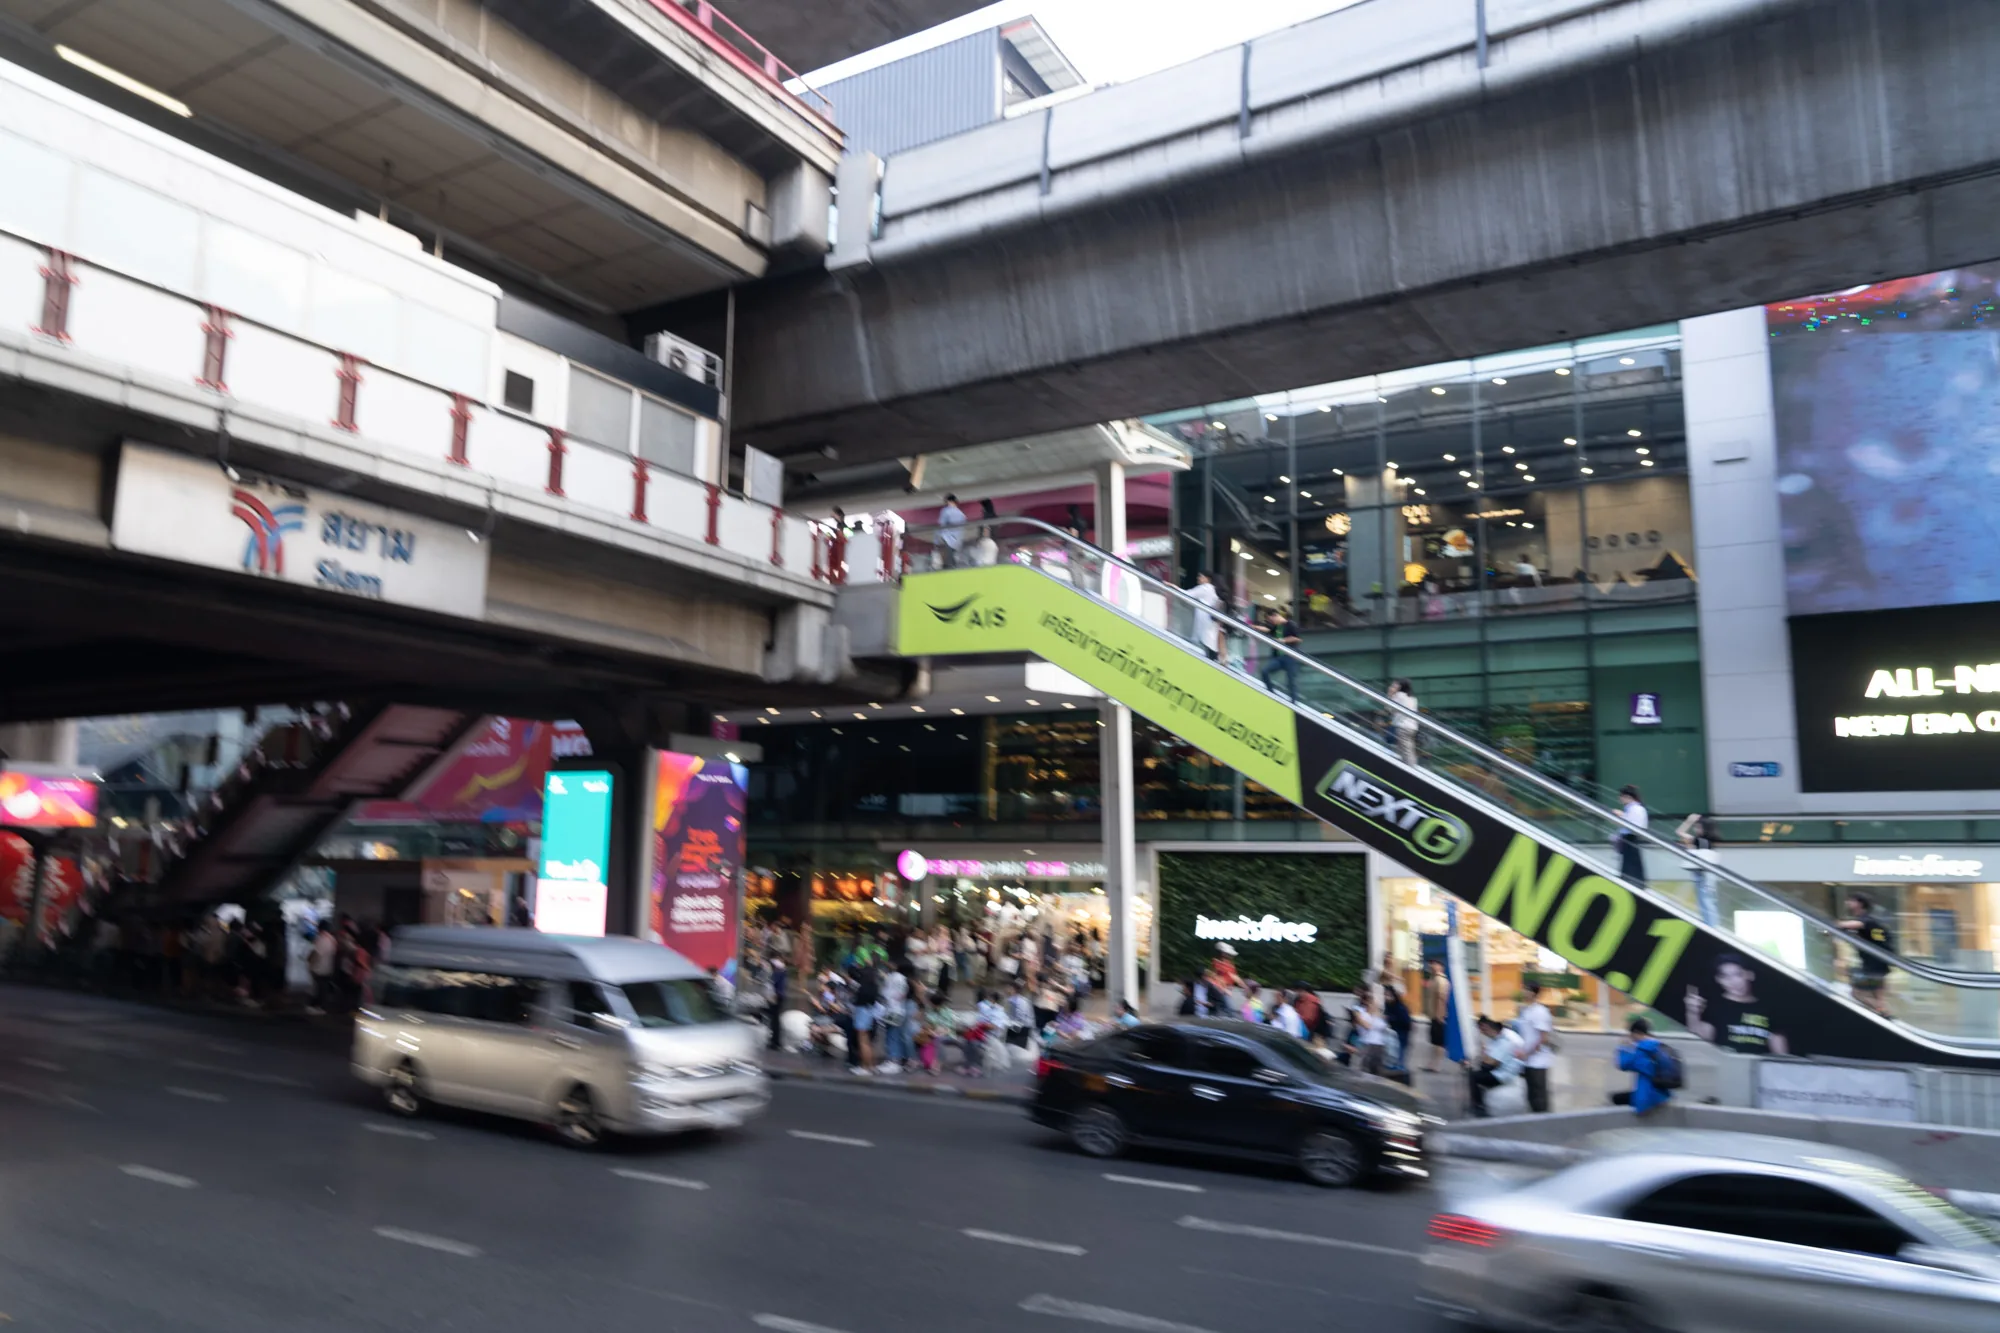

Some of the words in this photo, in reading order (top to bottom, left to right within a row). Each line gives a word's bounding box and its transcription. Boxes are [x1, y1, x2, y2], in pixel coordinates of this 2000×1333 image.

[319, 508, 416, 566] สยาม
[315, 557, 384, 598] Siam
[966, 605, 1008, 631] AIS
[1834, 714, 1910, 738] NEW
[1195, 913, 1319, 944] innisfree
[1477, 833, 1698, 1007] NO.1
